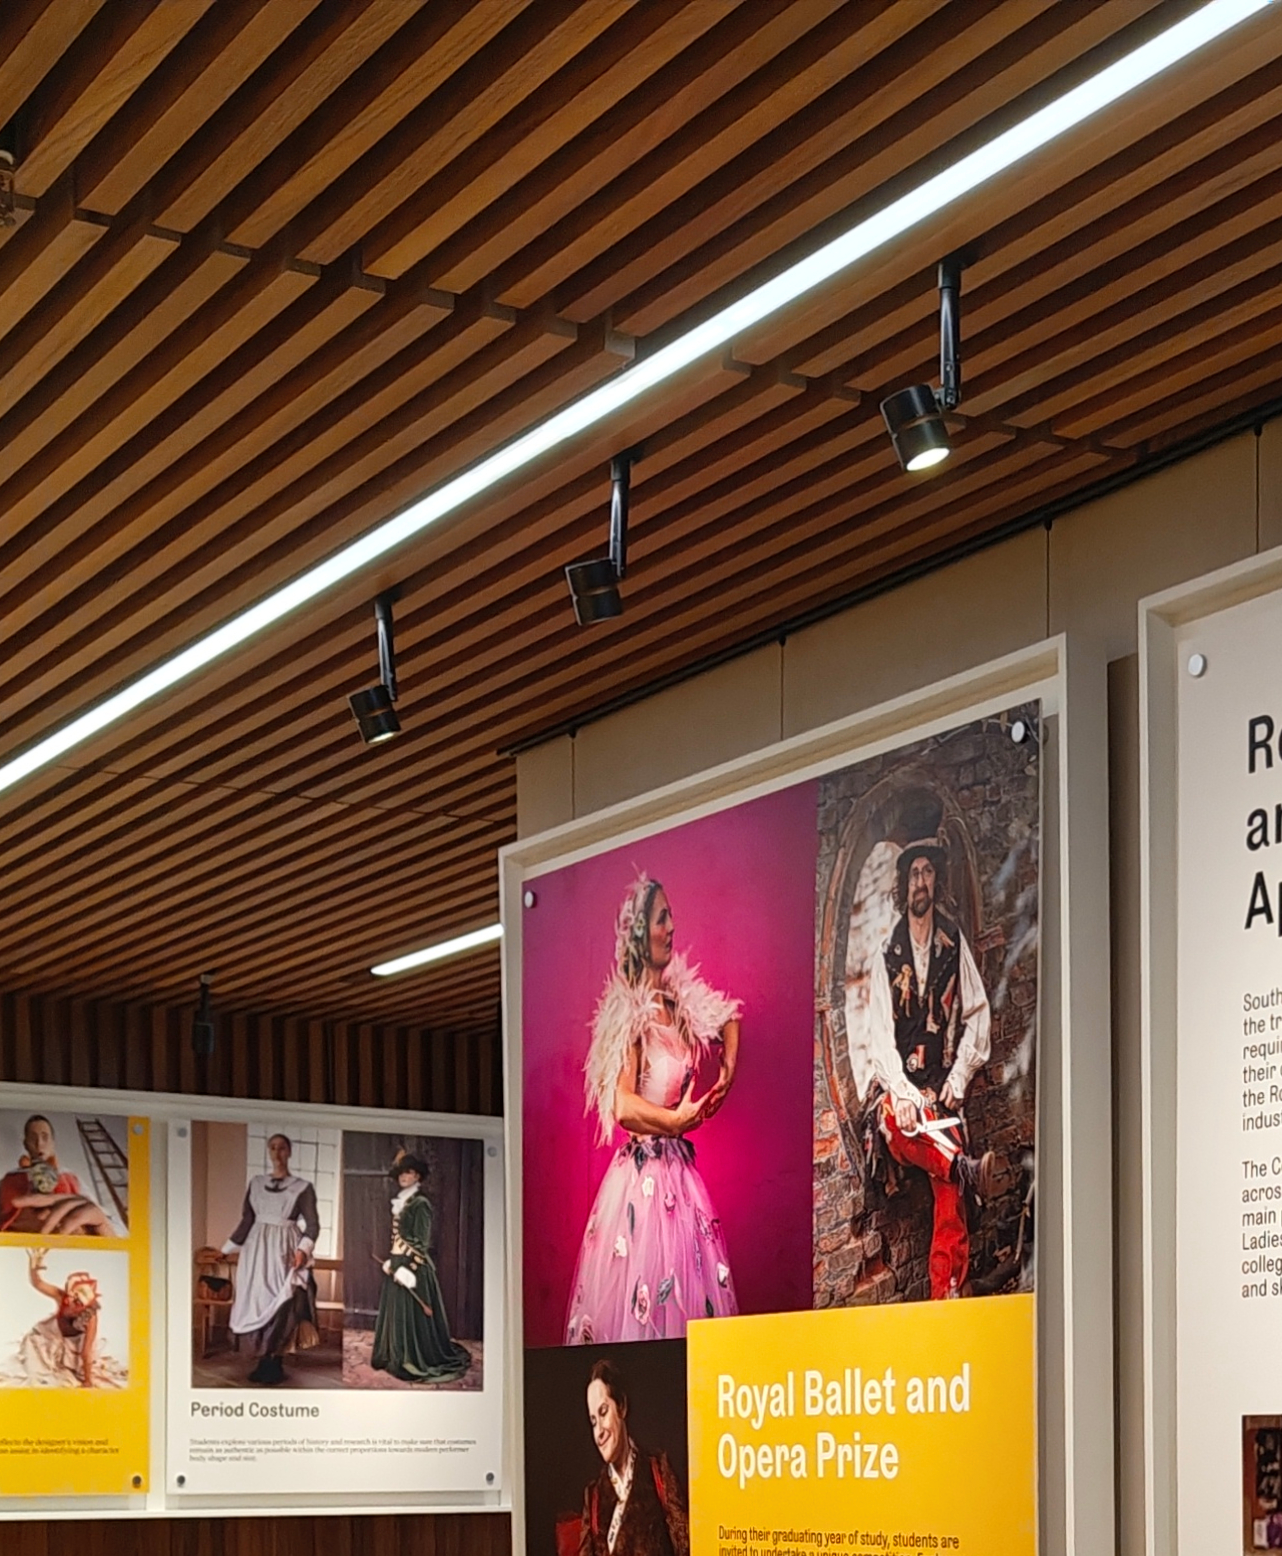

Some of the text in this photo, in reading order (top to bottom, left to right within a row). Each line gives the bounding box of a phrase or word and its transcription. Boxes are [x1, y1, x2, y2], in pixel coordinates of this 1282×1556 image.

[1243, 987, 1282, 1015] South
[1243, 1017, 1265, 1035] the
[1243, 1062, 1276, 1083] their
[1242, 1088, 1264, 1110] the
[1242, 1160, 1267, 1178] The
[1242, 1206, 1276, 1226] main
[1242, 1278, 1266, 1298] and
[717, 1362, 970, 1430] Royal Ballet and
[190, 1402, 320, 1418] Period Costume
[717, 1431, 899, 1490] Opera Prize
[719, 1525, 959, 1550] During their graduating year of study, students are
